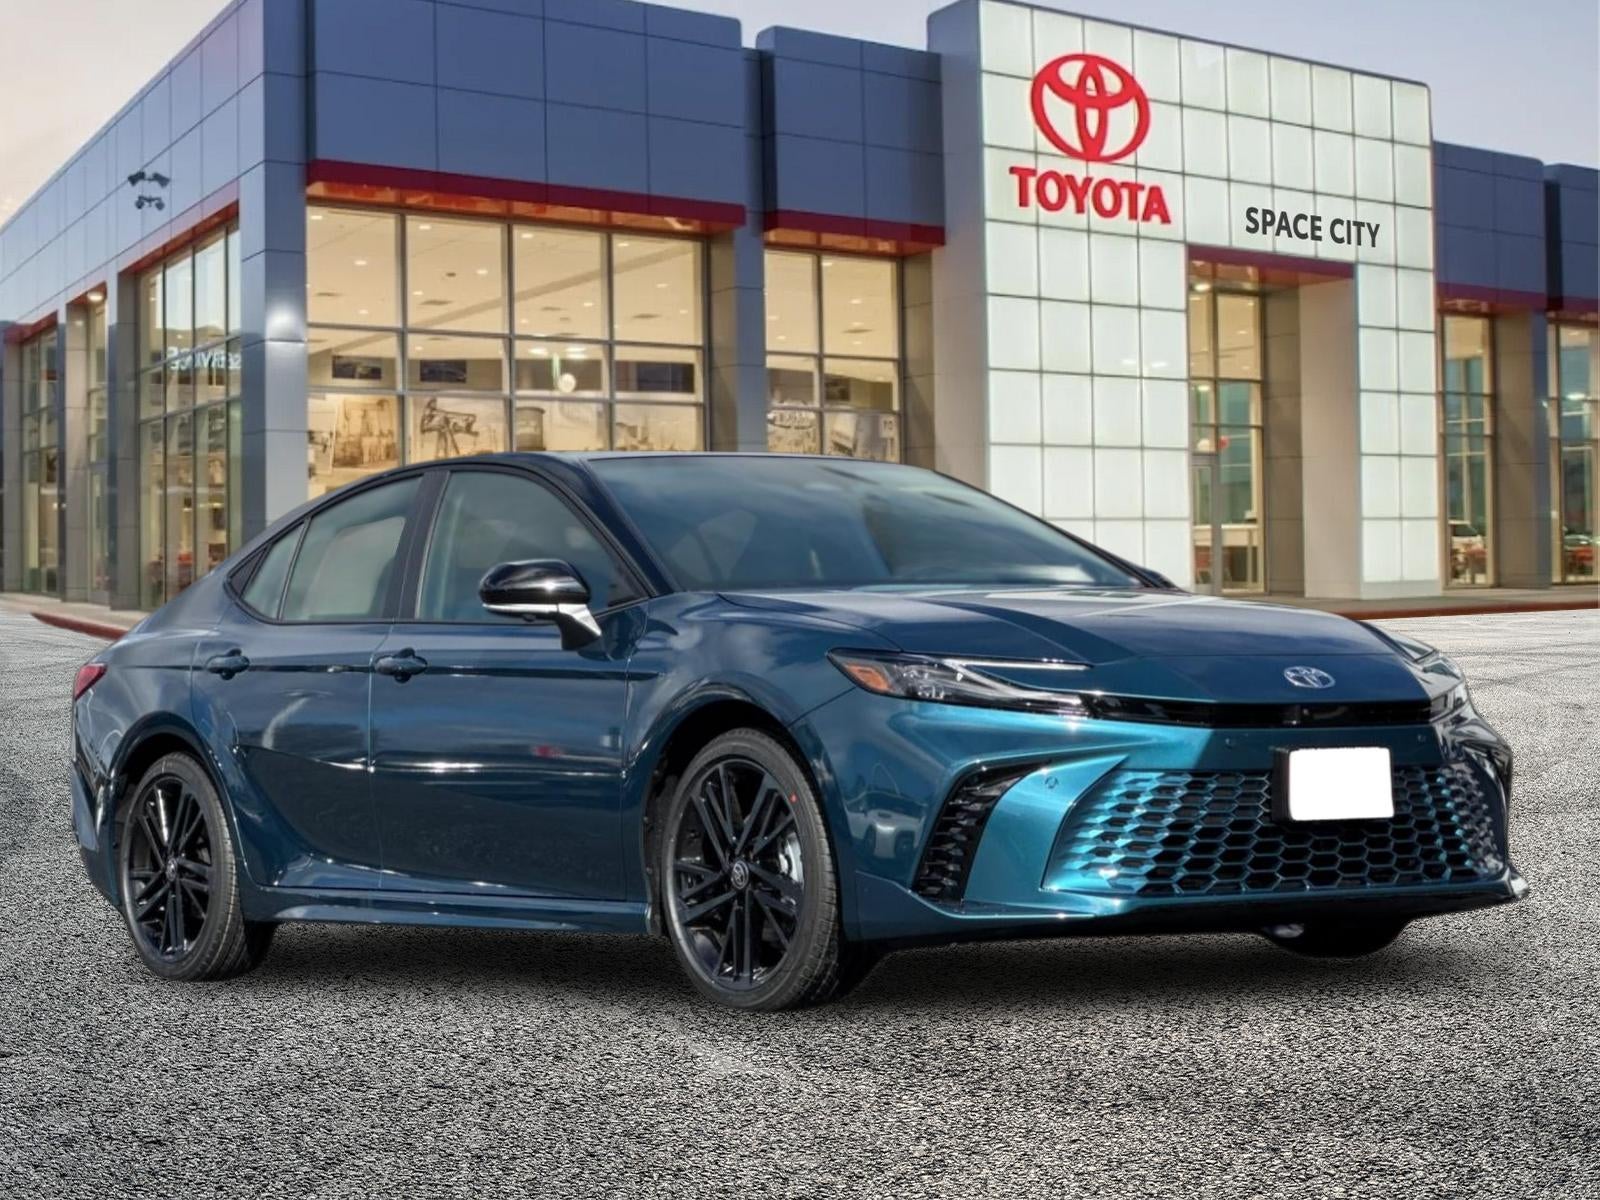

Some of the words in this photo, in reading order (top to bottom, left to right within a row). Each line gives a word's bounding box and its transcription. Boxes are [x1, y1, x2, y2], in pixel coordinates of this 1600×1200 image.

[1009, 166, 1171, 225] TOYOTA
[1245, 206, 1323, 242] SPACE
[1329, 217, 1381, 248] CITY
